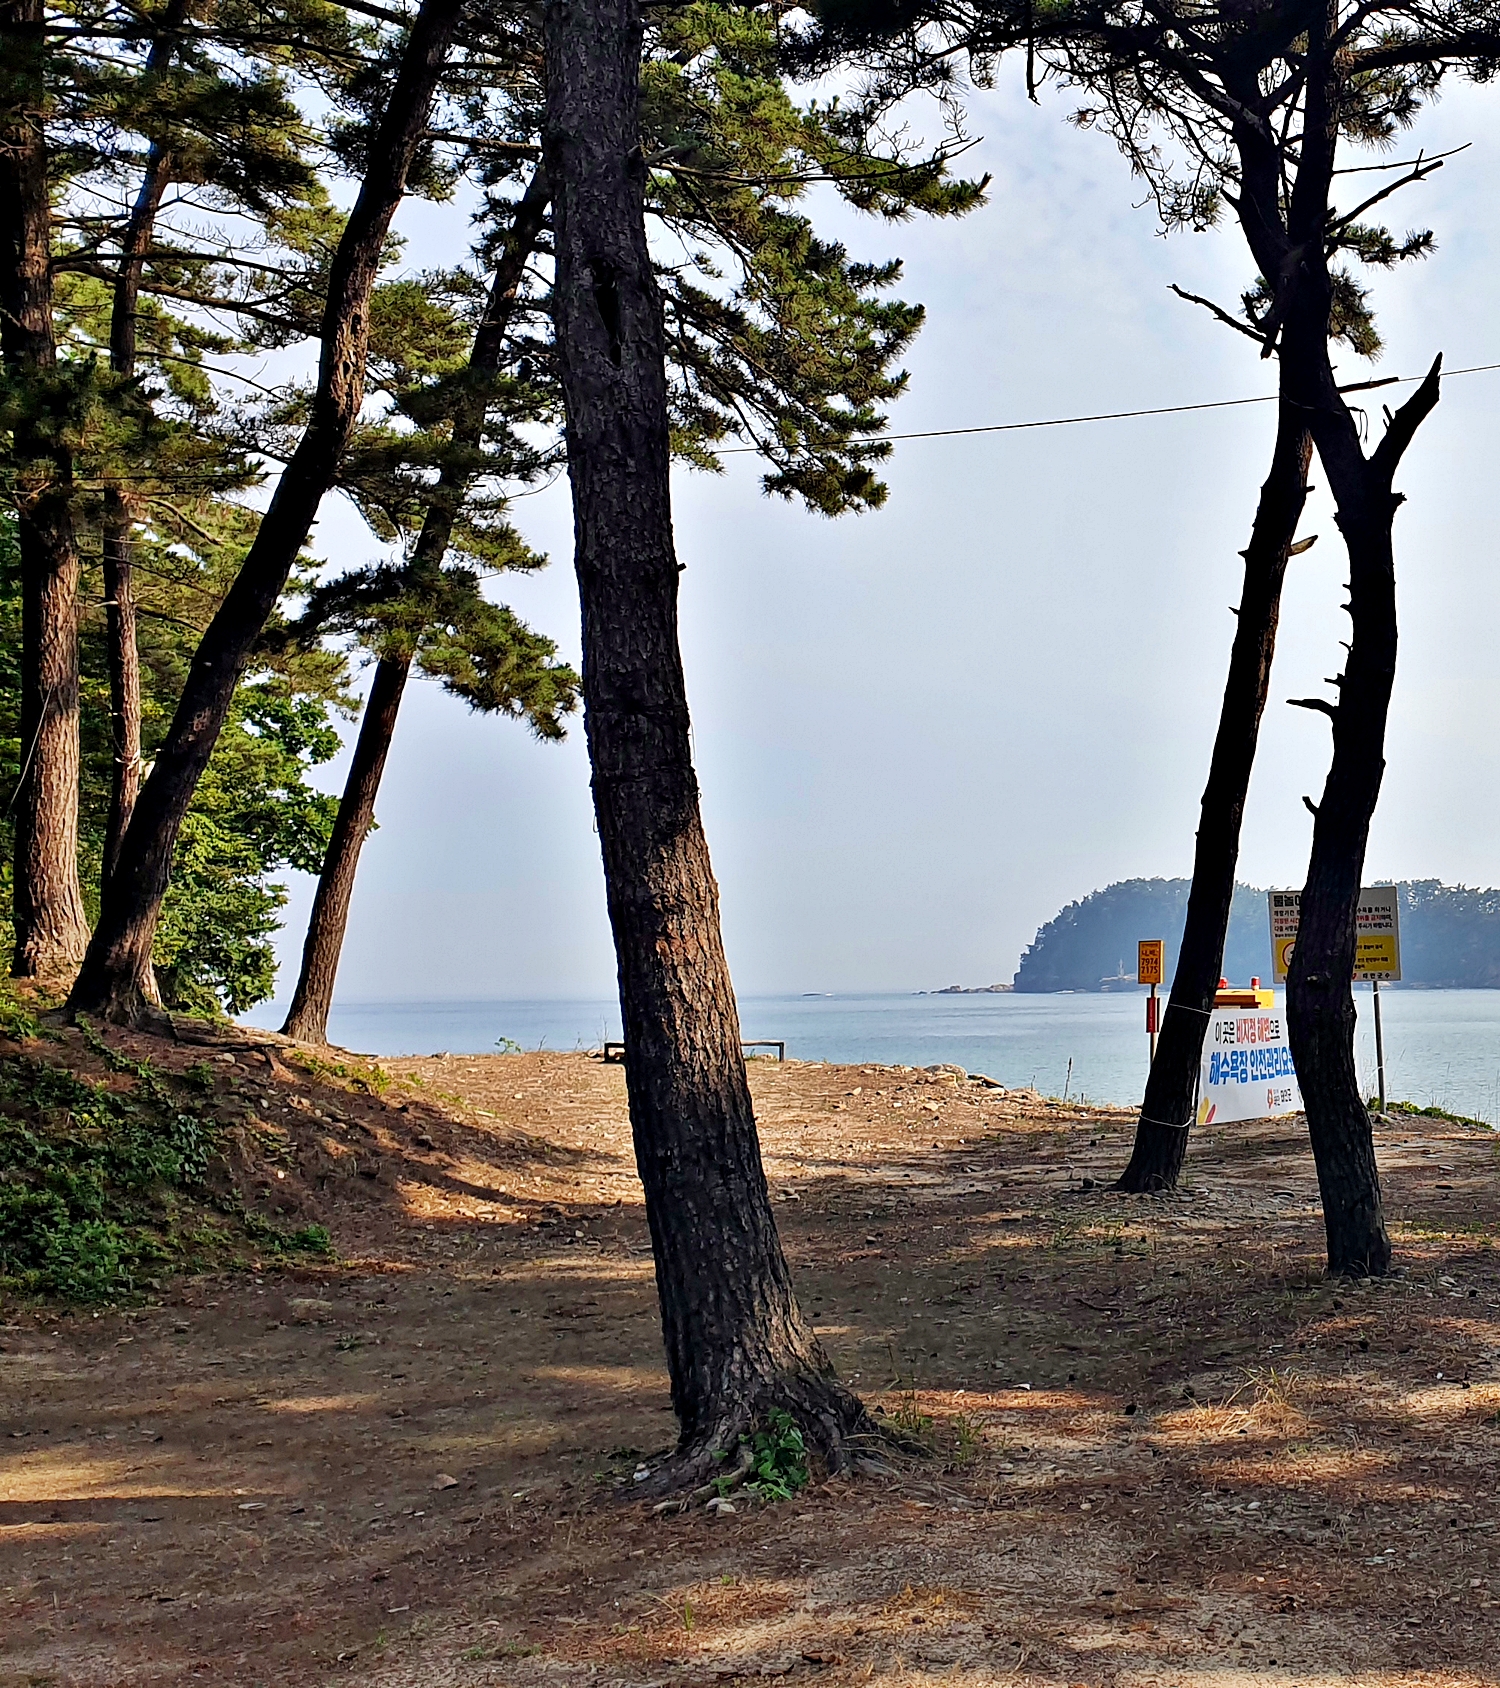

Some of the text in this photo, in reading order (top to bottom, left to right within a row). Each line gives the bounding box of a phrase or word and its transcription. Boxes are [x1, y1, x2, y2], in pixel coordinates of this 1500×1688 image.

[1141, 957, 1158, 966] 7974
[1141, 966, 1158, 975] 7175
[1236, 1017, 1256, 1044] 비지정
[1209, 1050, 1248, 1085] 해수욕장
